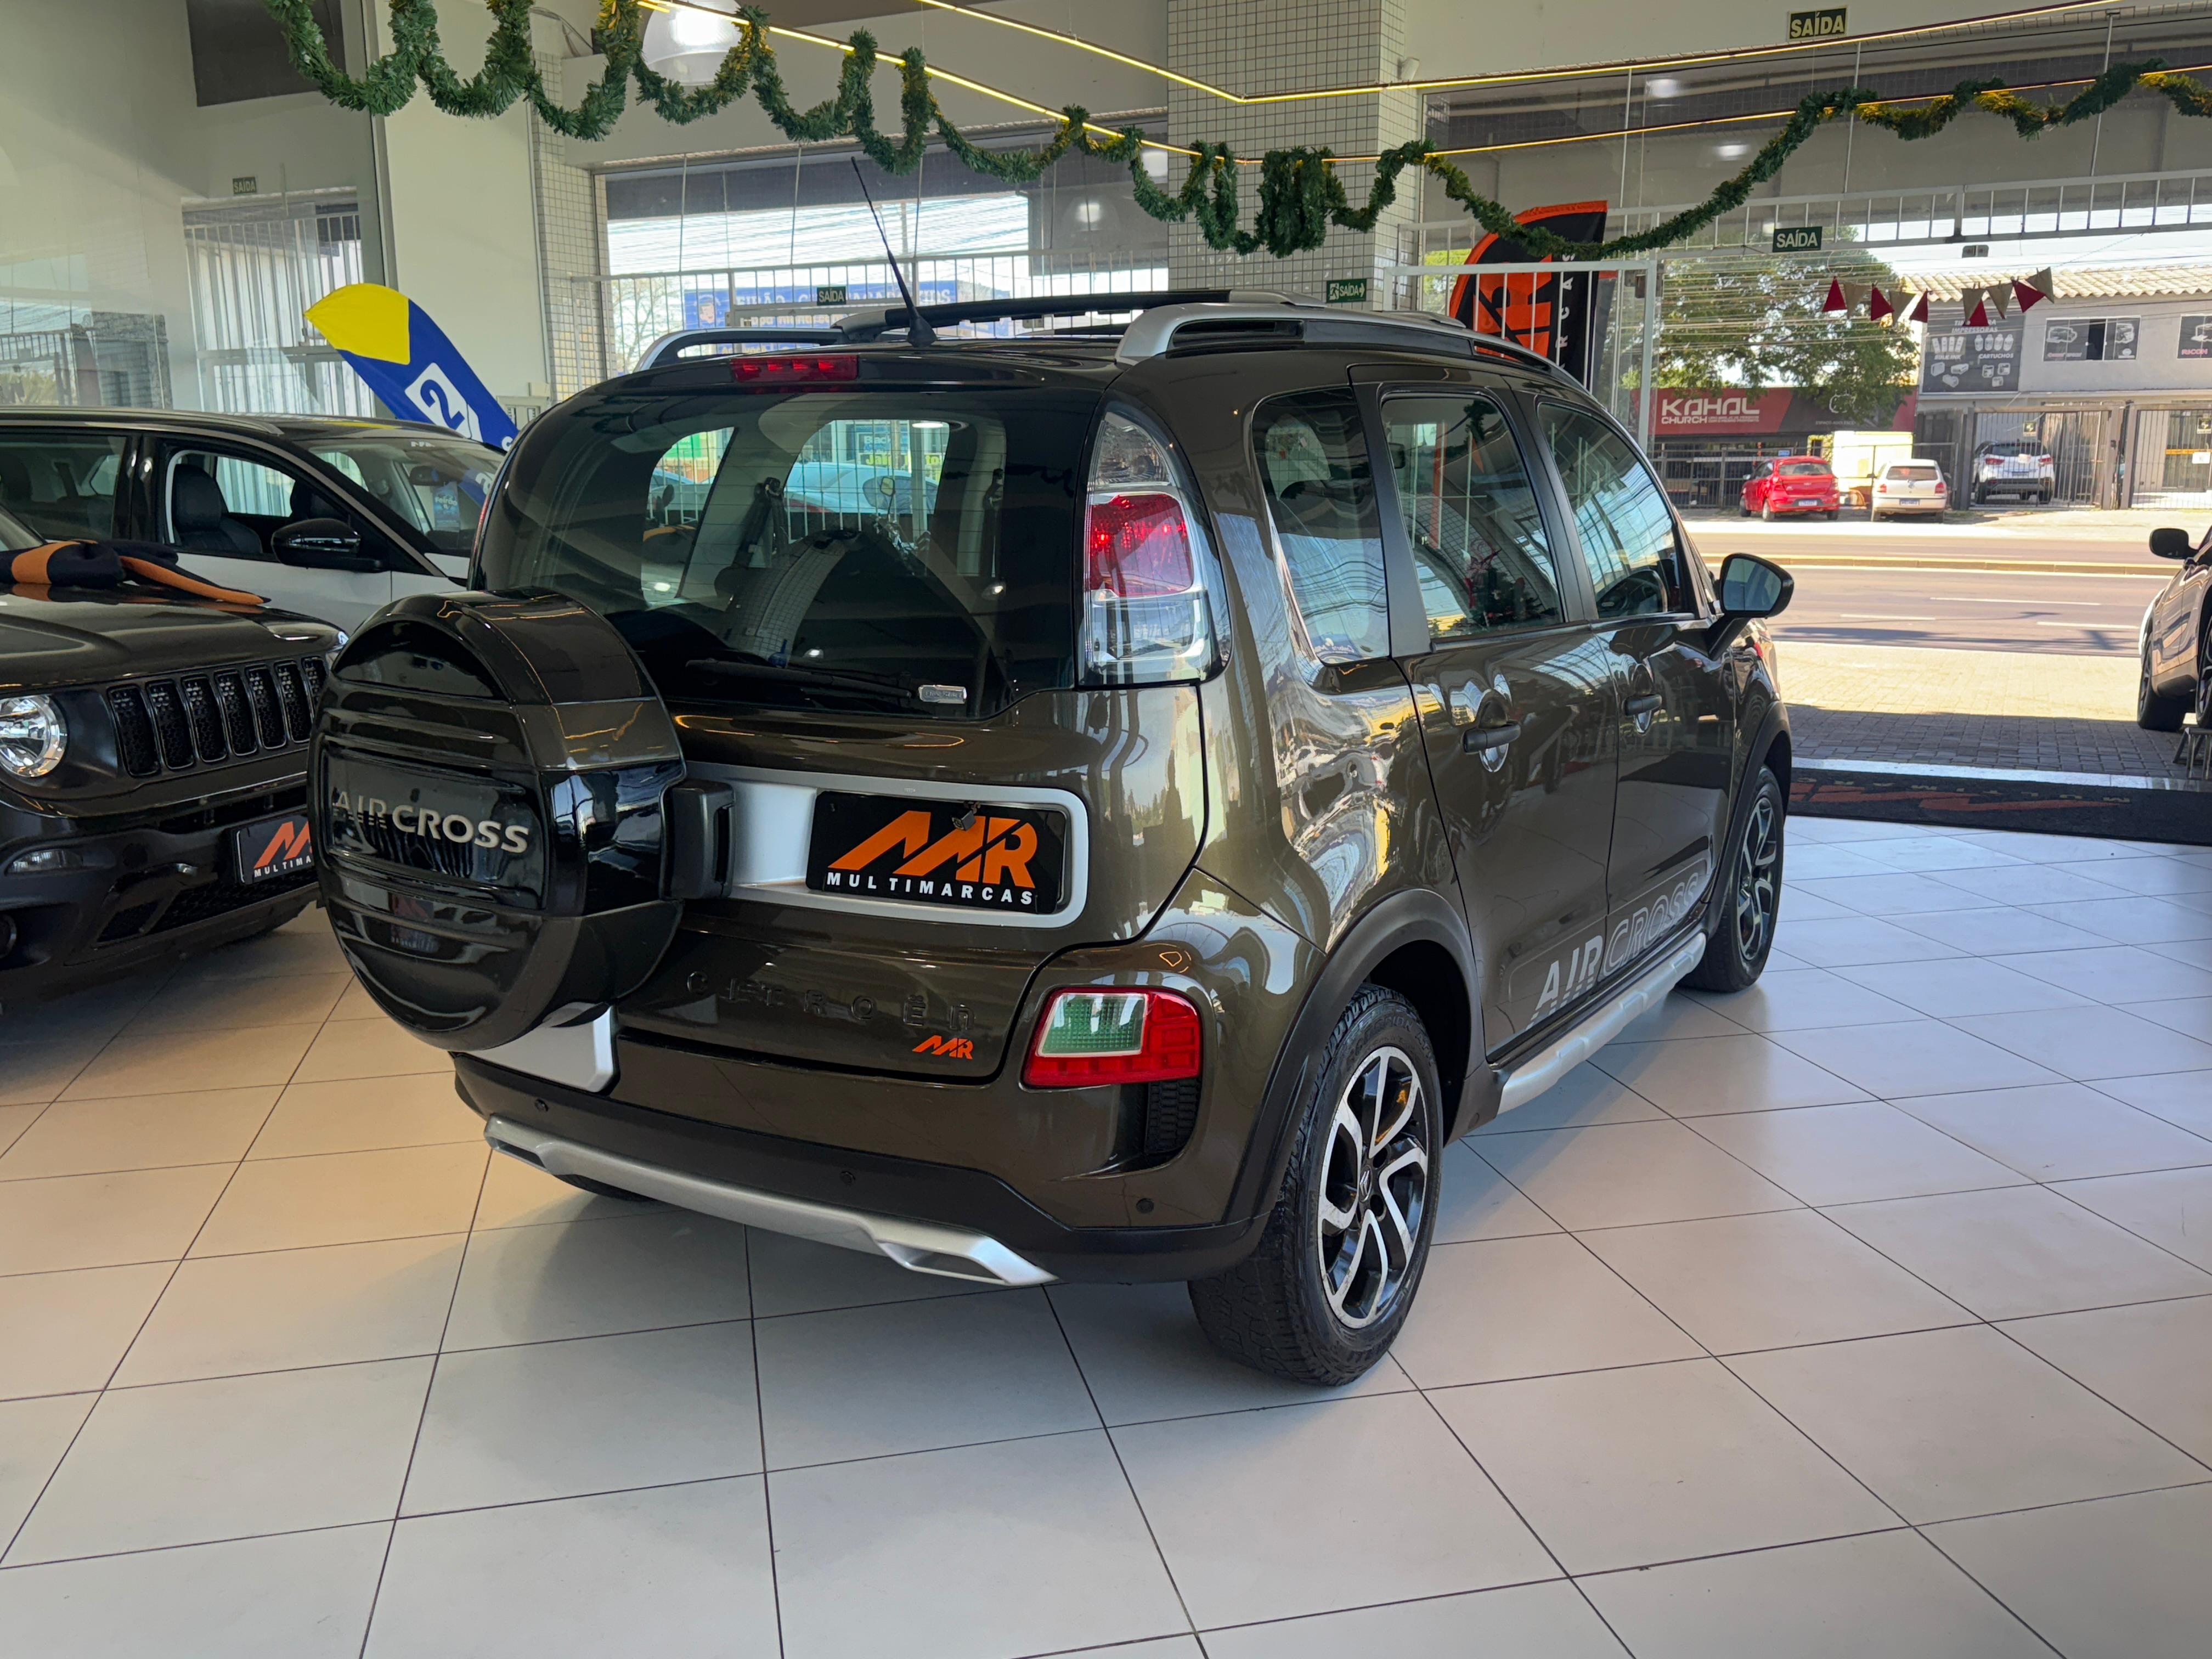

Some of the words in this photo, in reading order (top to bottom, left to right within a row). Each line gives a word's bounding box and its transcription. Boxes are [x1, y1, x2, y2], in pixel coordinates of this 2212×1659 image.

[1791, 12, 1844, 38] SAÍDA
[234, 178, 256, 193] SAÍDA
[1776, 229, 1818, 249] SAÍDA
[819, 289, 844, 303] SAÍDA
[1339, 283, 1359, 297] SAÍDA
[1662, 398, 1760, 416] KAHAL
[1661, 416, 1707, 424] CHURCH
[254, 855, 312, 878] MULTIMA
[826, 871, 1032, 905] MULTIMARCAS
